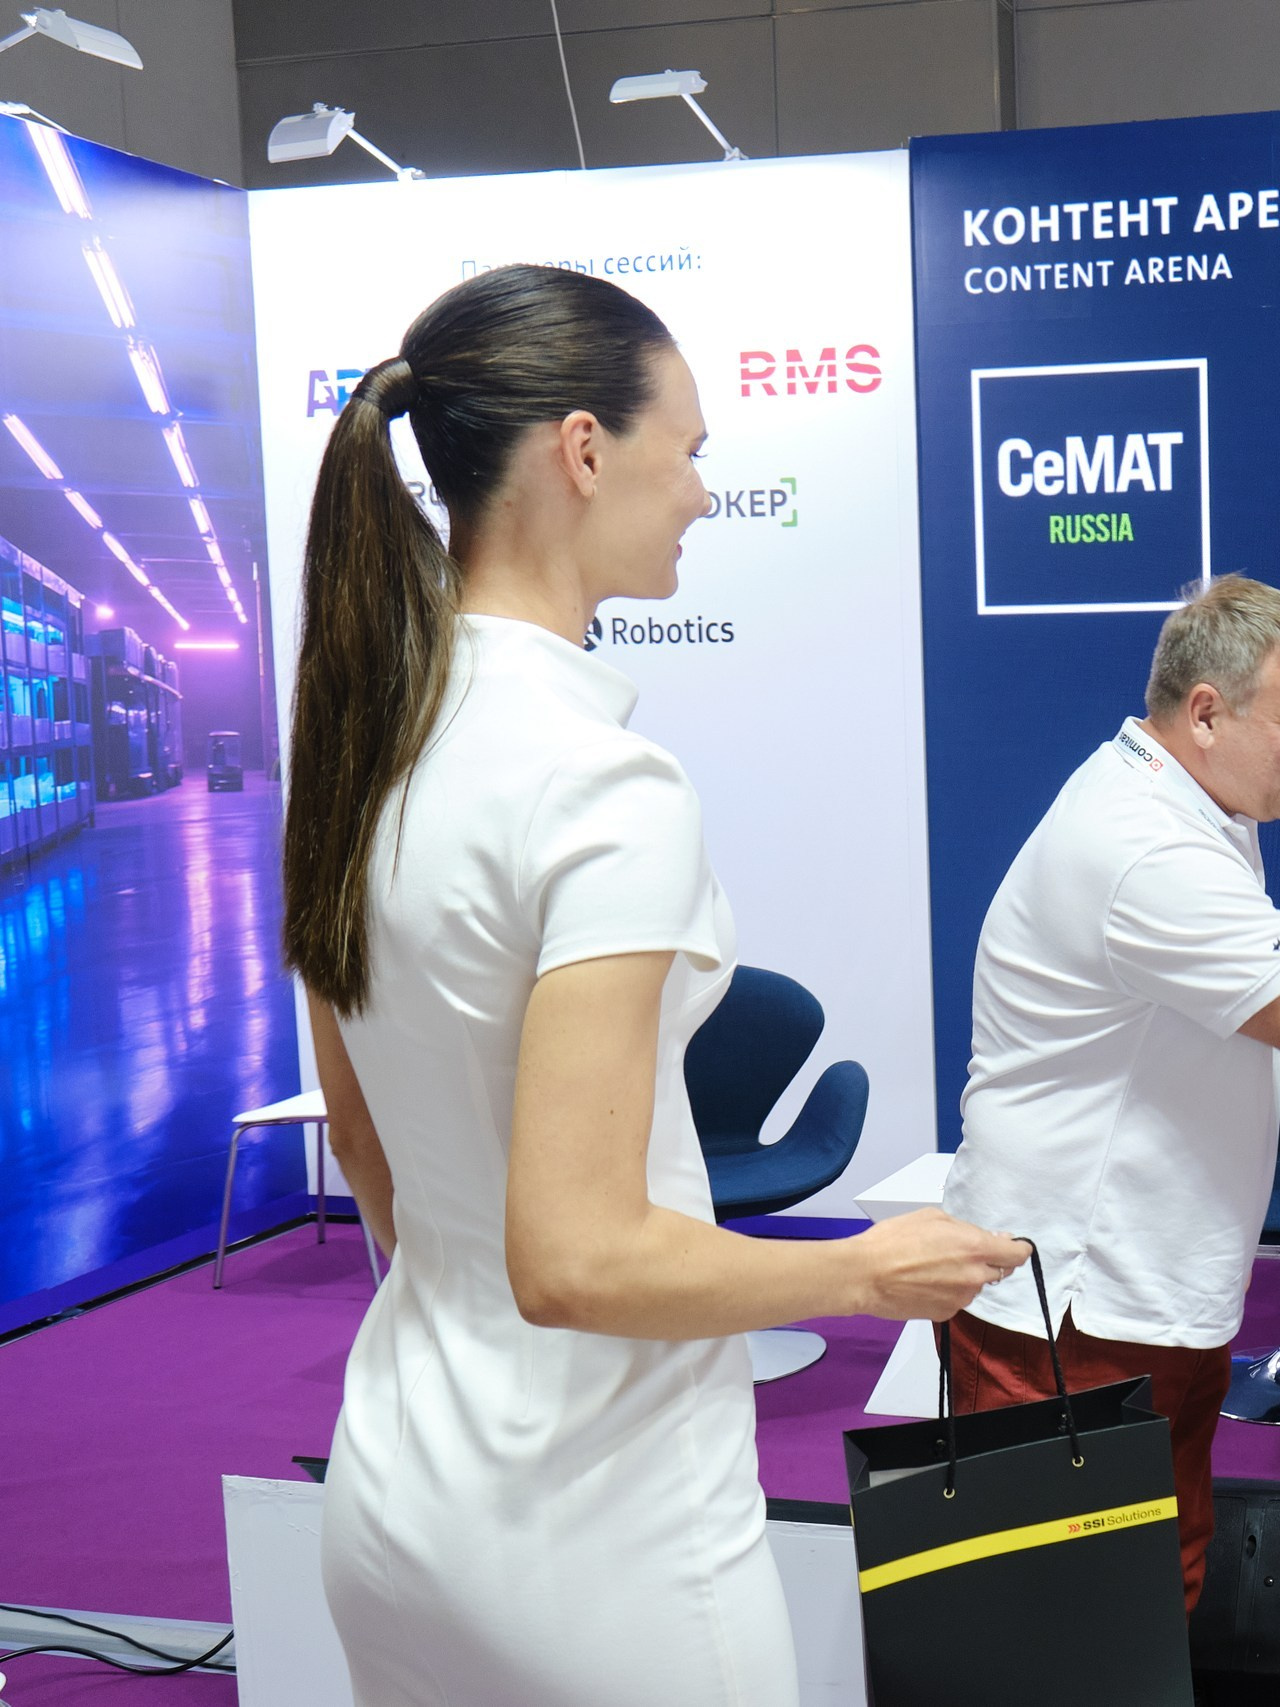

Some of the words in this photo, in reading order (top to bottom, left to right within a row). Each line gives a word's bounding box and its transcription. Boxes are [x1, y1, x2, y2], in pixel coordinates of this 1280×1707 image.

[963, 196, 1179, 247] КОНТЕНТ
[603, 246, 702, 275] сессий:
[963, 260, 1115, 295] CONTENT
[1123, 253, 1234, 286] ARENA
[739, 344, 882, 397] RMS
[997, 431, 1184, 498] CeMAT
[1049, 513, 1135, 544] RUSSIA
[611, 615, 735, 645] Robotics
[1083, 1518, 1105, 1530] SSI
[1106, 1508, 1162, 1526] Solutions
